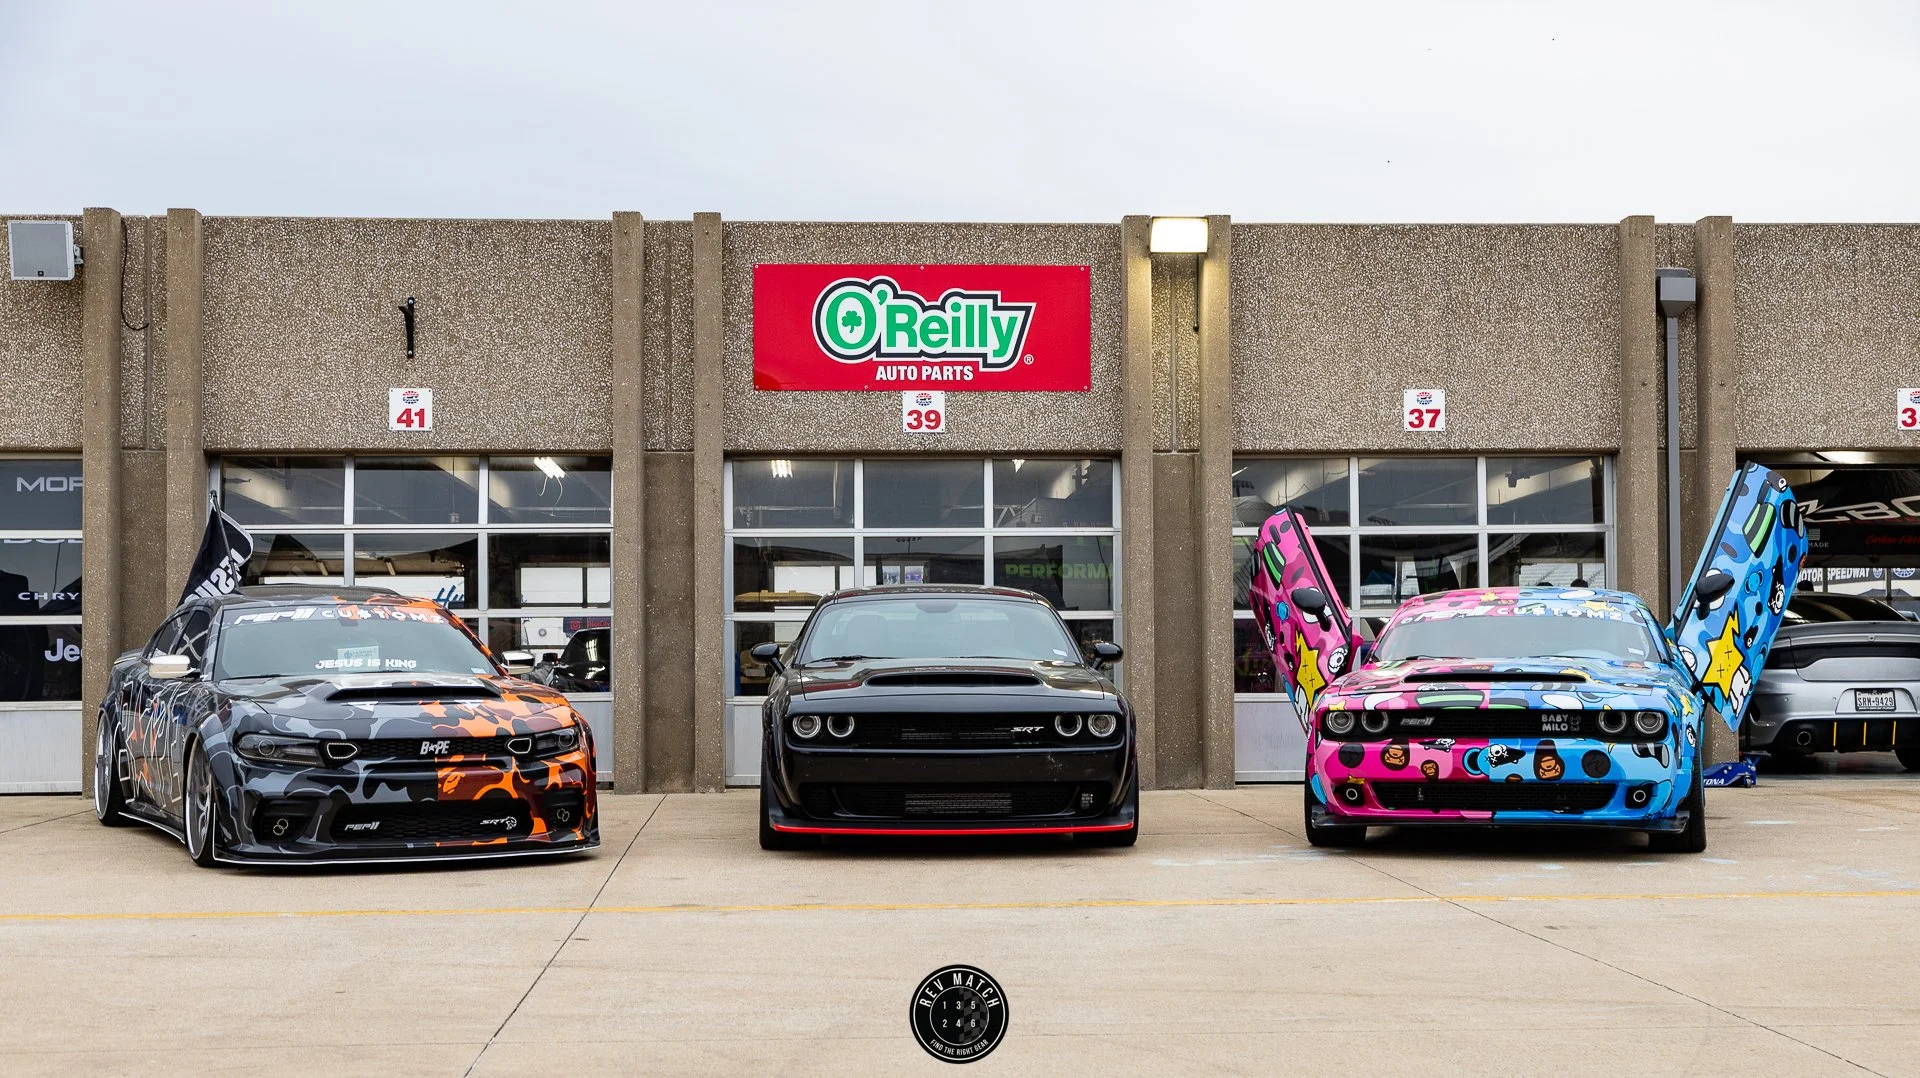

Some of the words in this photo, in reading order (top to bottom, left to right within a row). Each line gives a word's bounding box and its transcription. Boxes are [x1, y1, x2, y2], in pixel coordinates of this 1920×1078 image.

[826, 289, 1018, 358] O'Reilly
[876, 366, 917, 381] AUTO
[922, 366, 974, 381] PARTS
[396, 408, 425, 428] 41
[907, 409, 941, 430] 39
[1408, 408, 1441, 428] 37
[44, 638, 82, 662] Je
[315, 658, 364, 669] JESUS
[367, 658, 381, 667] IS
[385, 658, 417, 669] KING
[1541, 714, 1569, 722] BABY
[1541, 723, 1569, 732] MILO
